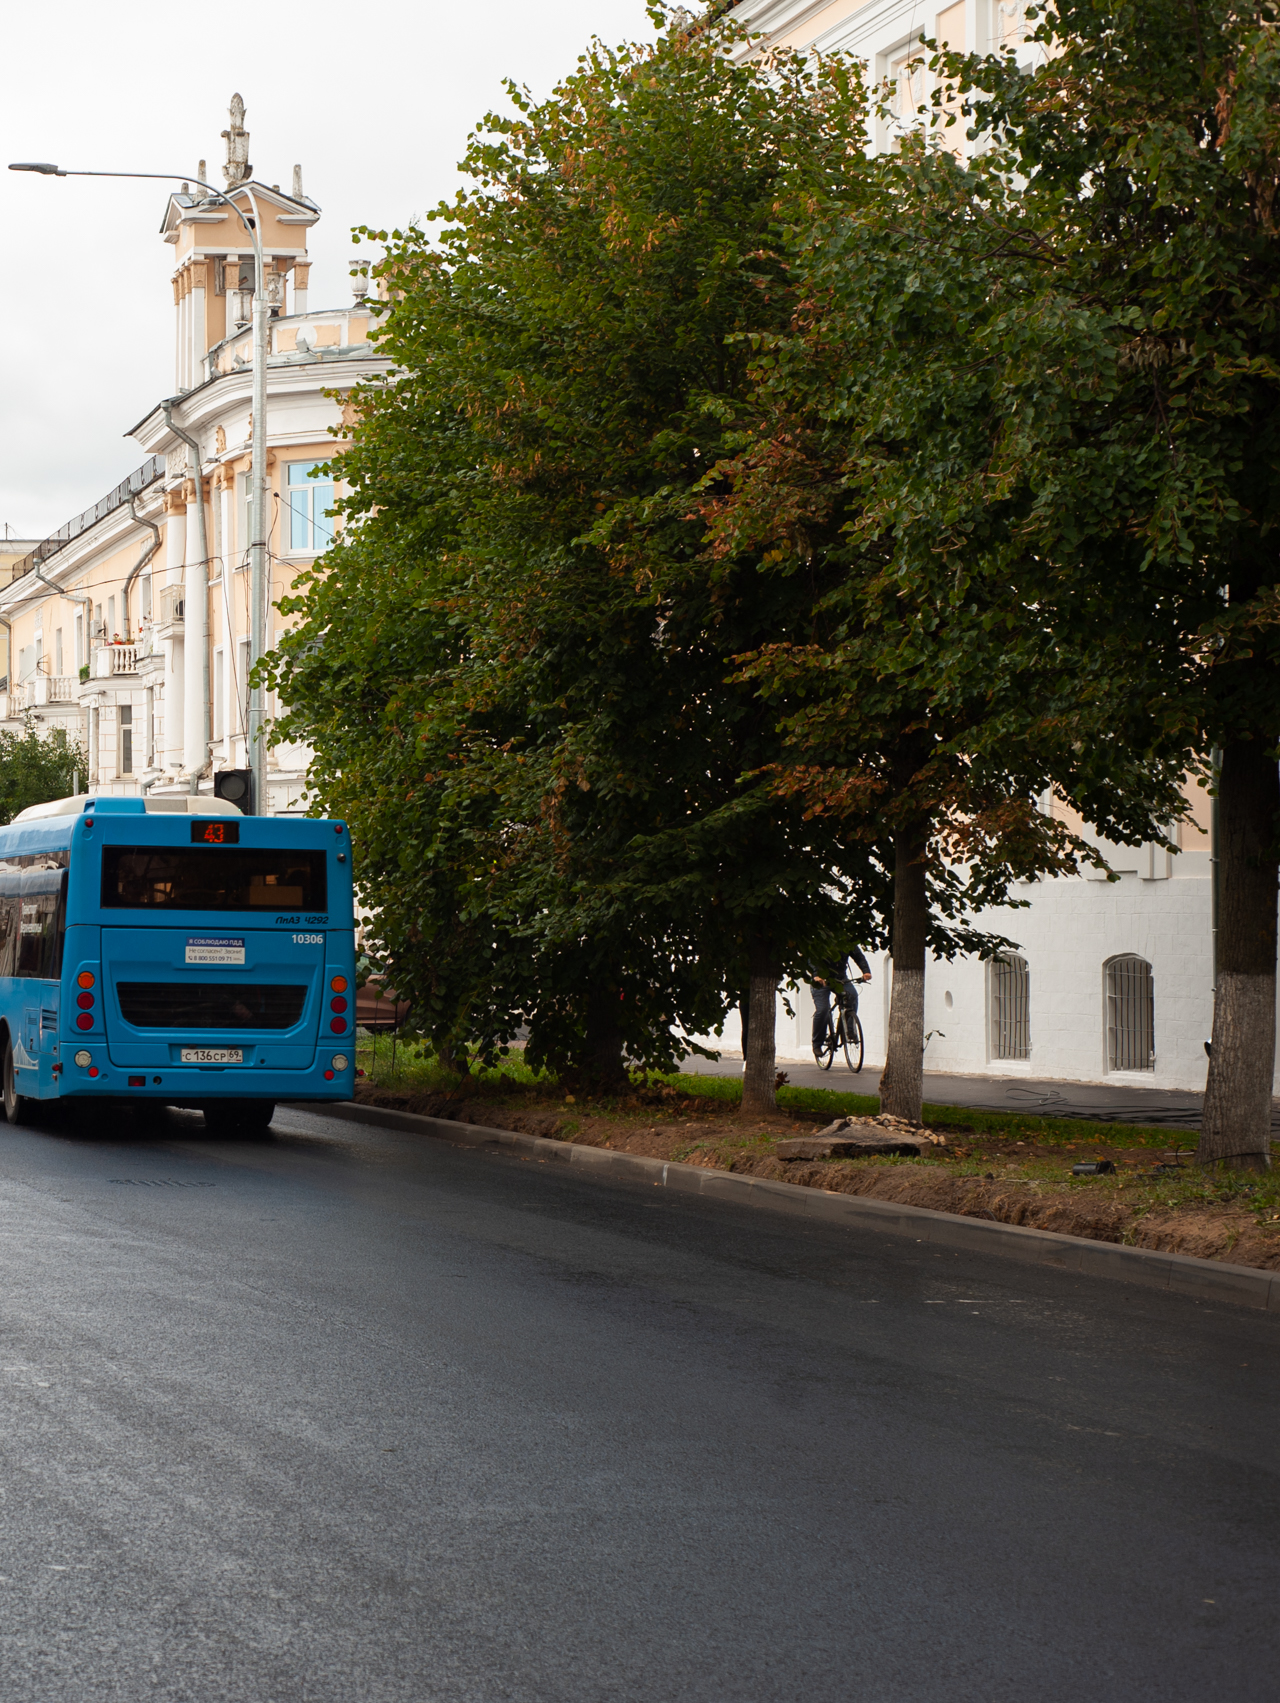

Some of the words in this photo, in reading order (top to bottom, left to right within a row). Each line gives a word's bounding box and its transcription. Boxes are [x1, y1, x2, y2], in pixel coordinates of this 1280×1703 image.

[204, 824, 223, 842] 43
[305, 916, 329, 924] 4292
[292, 934, 323, 944] 10306
[229, 1050, 239, 1058] 69
